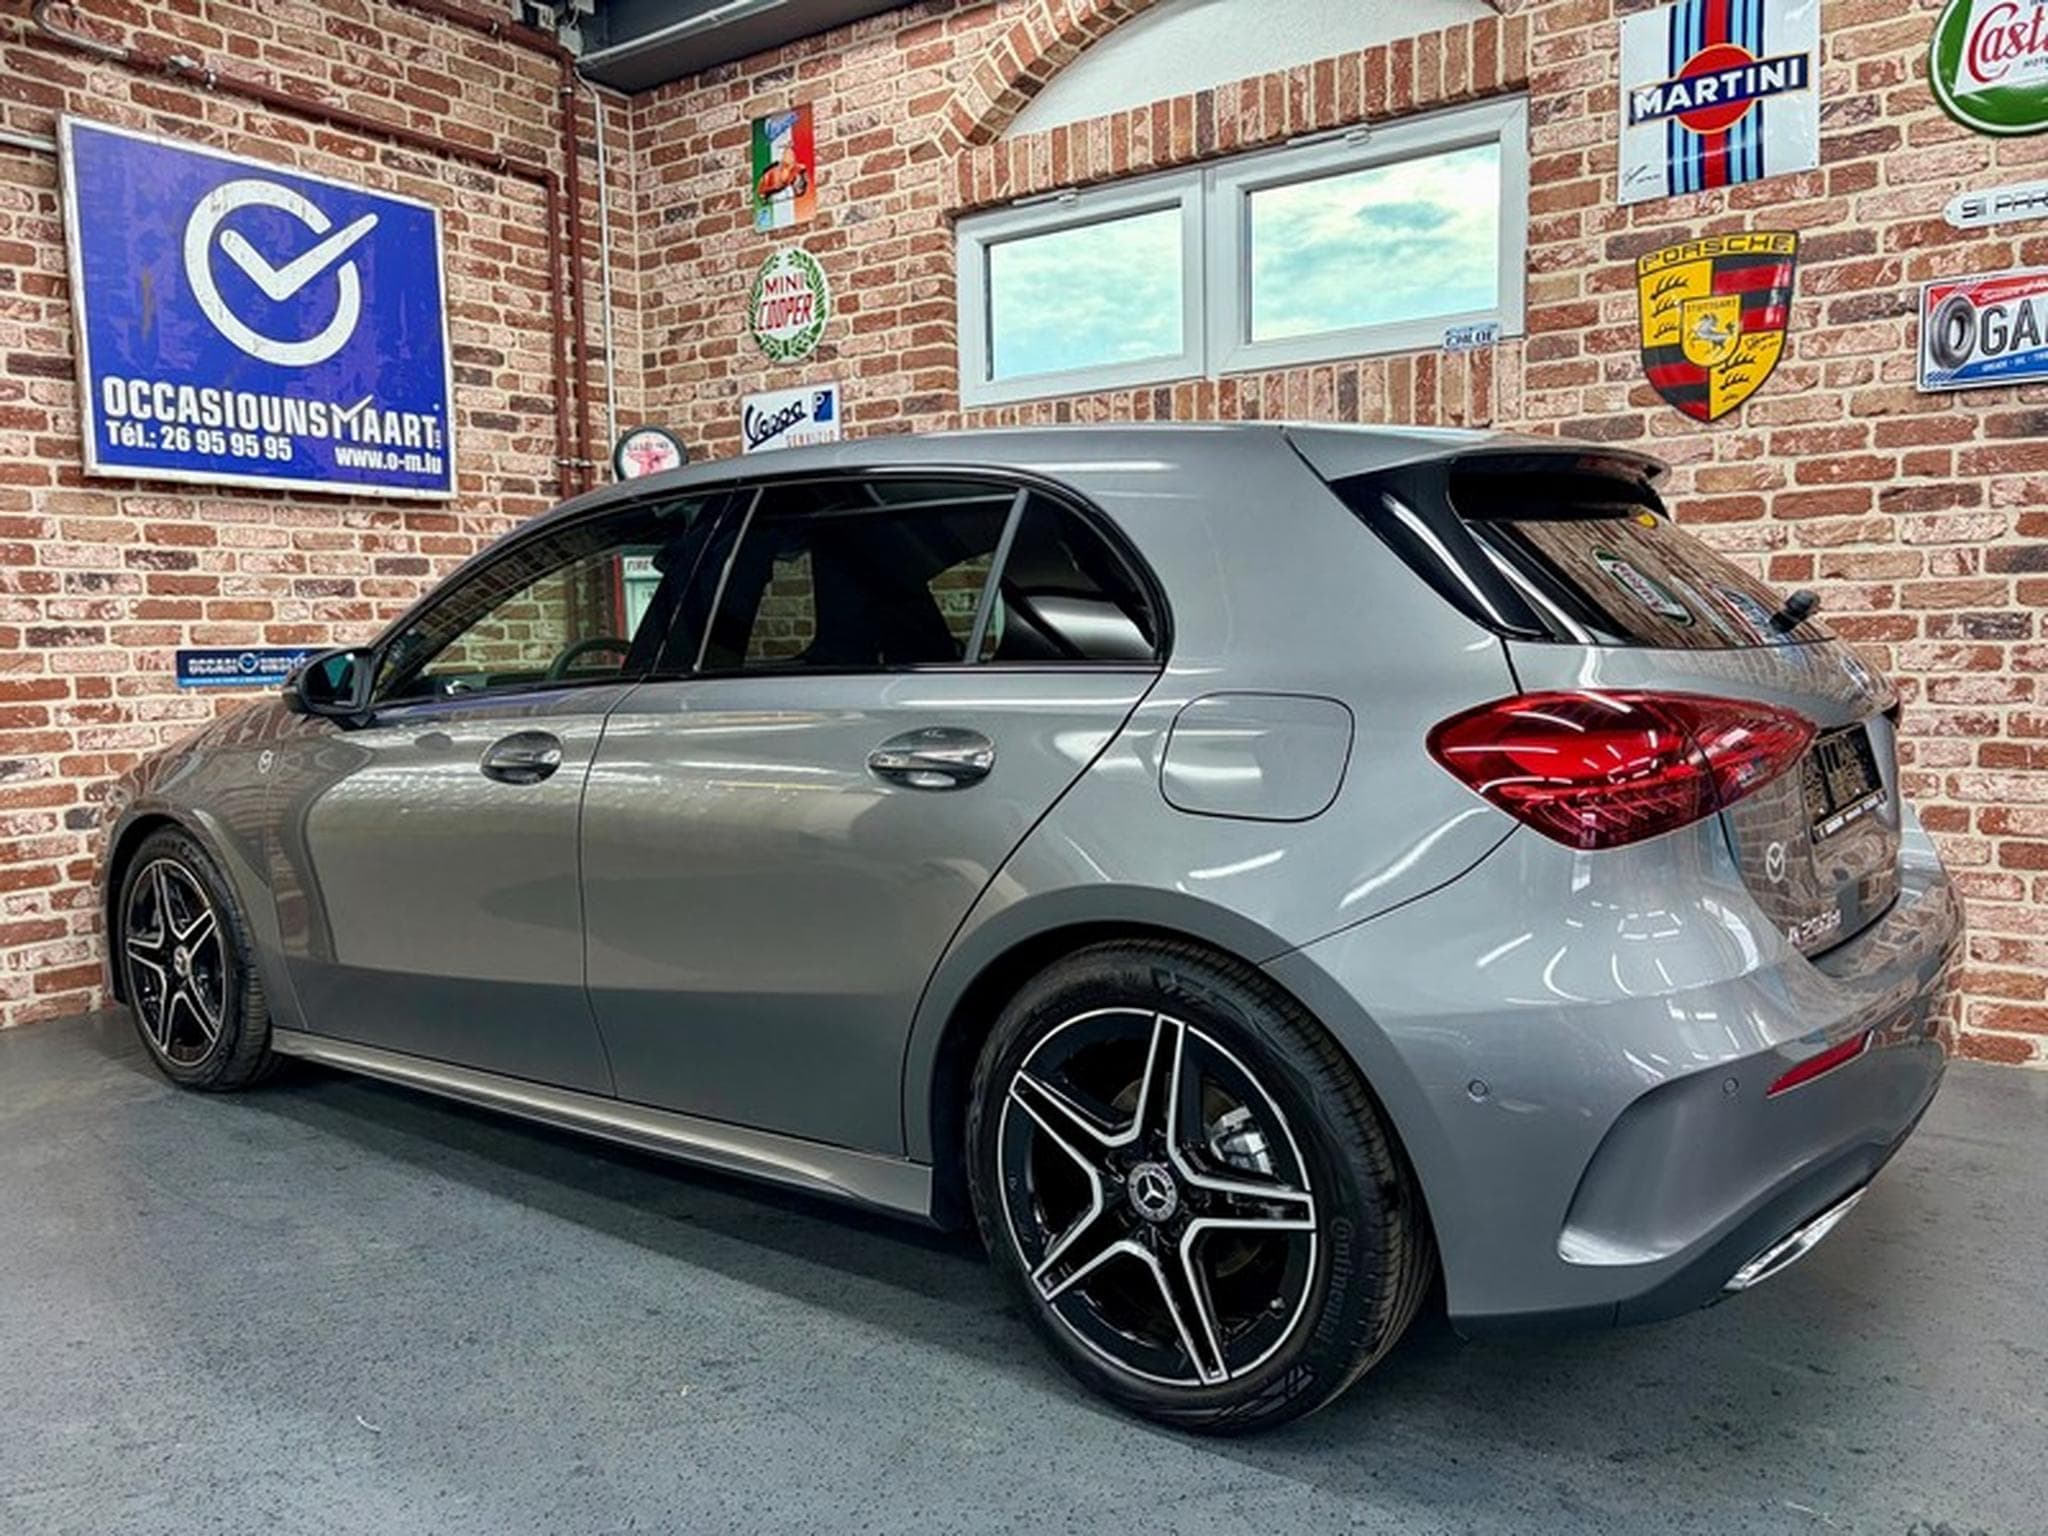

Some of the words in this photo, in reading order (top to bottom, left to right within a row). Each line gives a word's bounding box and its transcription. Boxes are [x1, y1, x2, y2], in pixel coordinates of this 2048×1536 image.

[1967, 2, 2048, 83] Cast
[1633, 58, 1799, 119] MARTINI
[1643, 235, 1790, 272] PORSCHE
[765, 272, 804, 296] MINI
[759, 293, 813, 331] COOPER
[102, 375, 437, 449] OCCASIOUNSMAART
[745, 400, 807, 450] Vespa
[105, 420, 157, 448] Tél.:
[160, 425, 191, 452] 26
[195, 429, 226, 455] 95
[230, 431, 260, 459] 95
[264, 435, 293, 461] 95
[334, 446, 443, 475] www.o-m.lu
